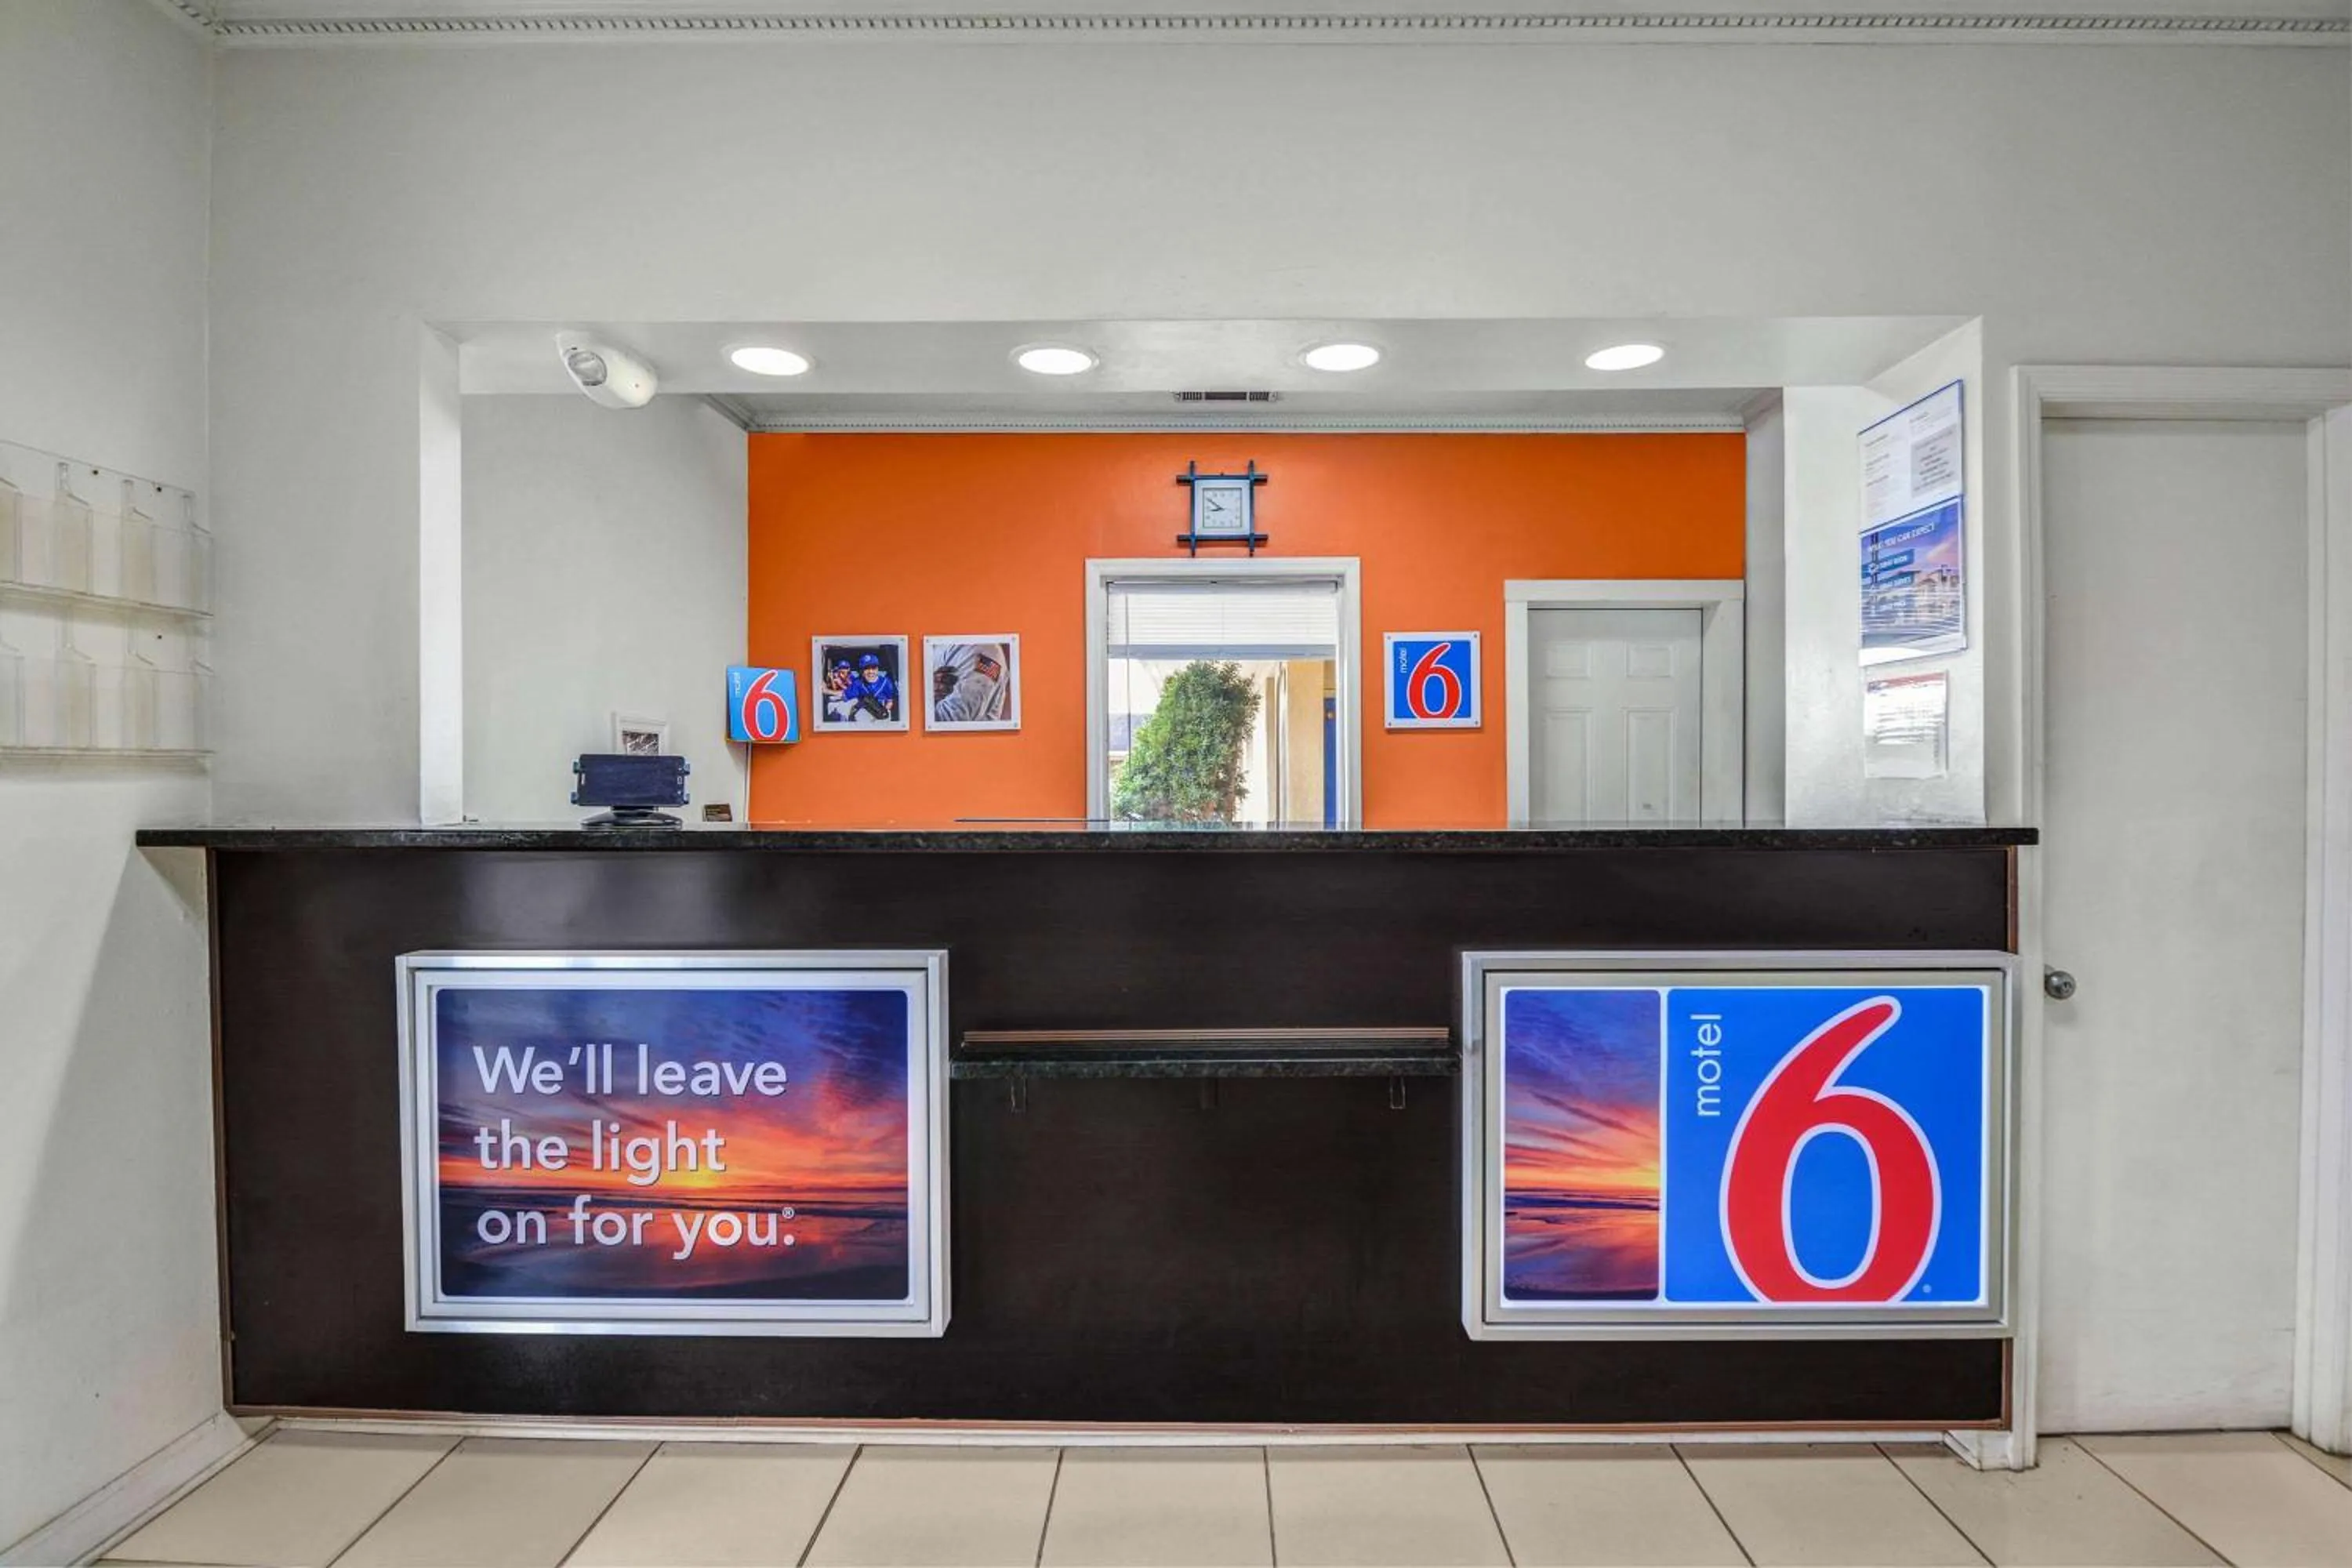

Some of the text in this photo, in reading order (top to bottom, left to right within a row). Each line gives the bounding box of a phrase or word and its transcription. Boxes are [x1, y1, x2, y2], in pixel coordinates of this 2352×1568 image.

[742, 669, 790, 741] 6
[1406, 642, 1462, 719] 6
[473, 1044, 786, 1096] We'll leave
[474, 1120, 727, 1186] the light
[1690, 995, 1942, 1303] motel 6
[477, 1209, 547, 1246] on
[568, 1194, 653, 1246] for
